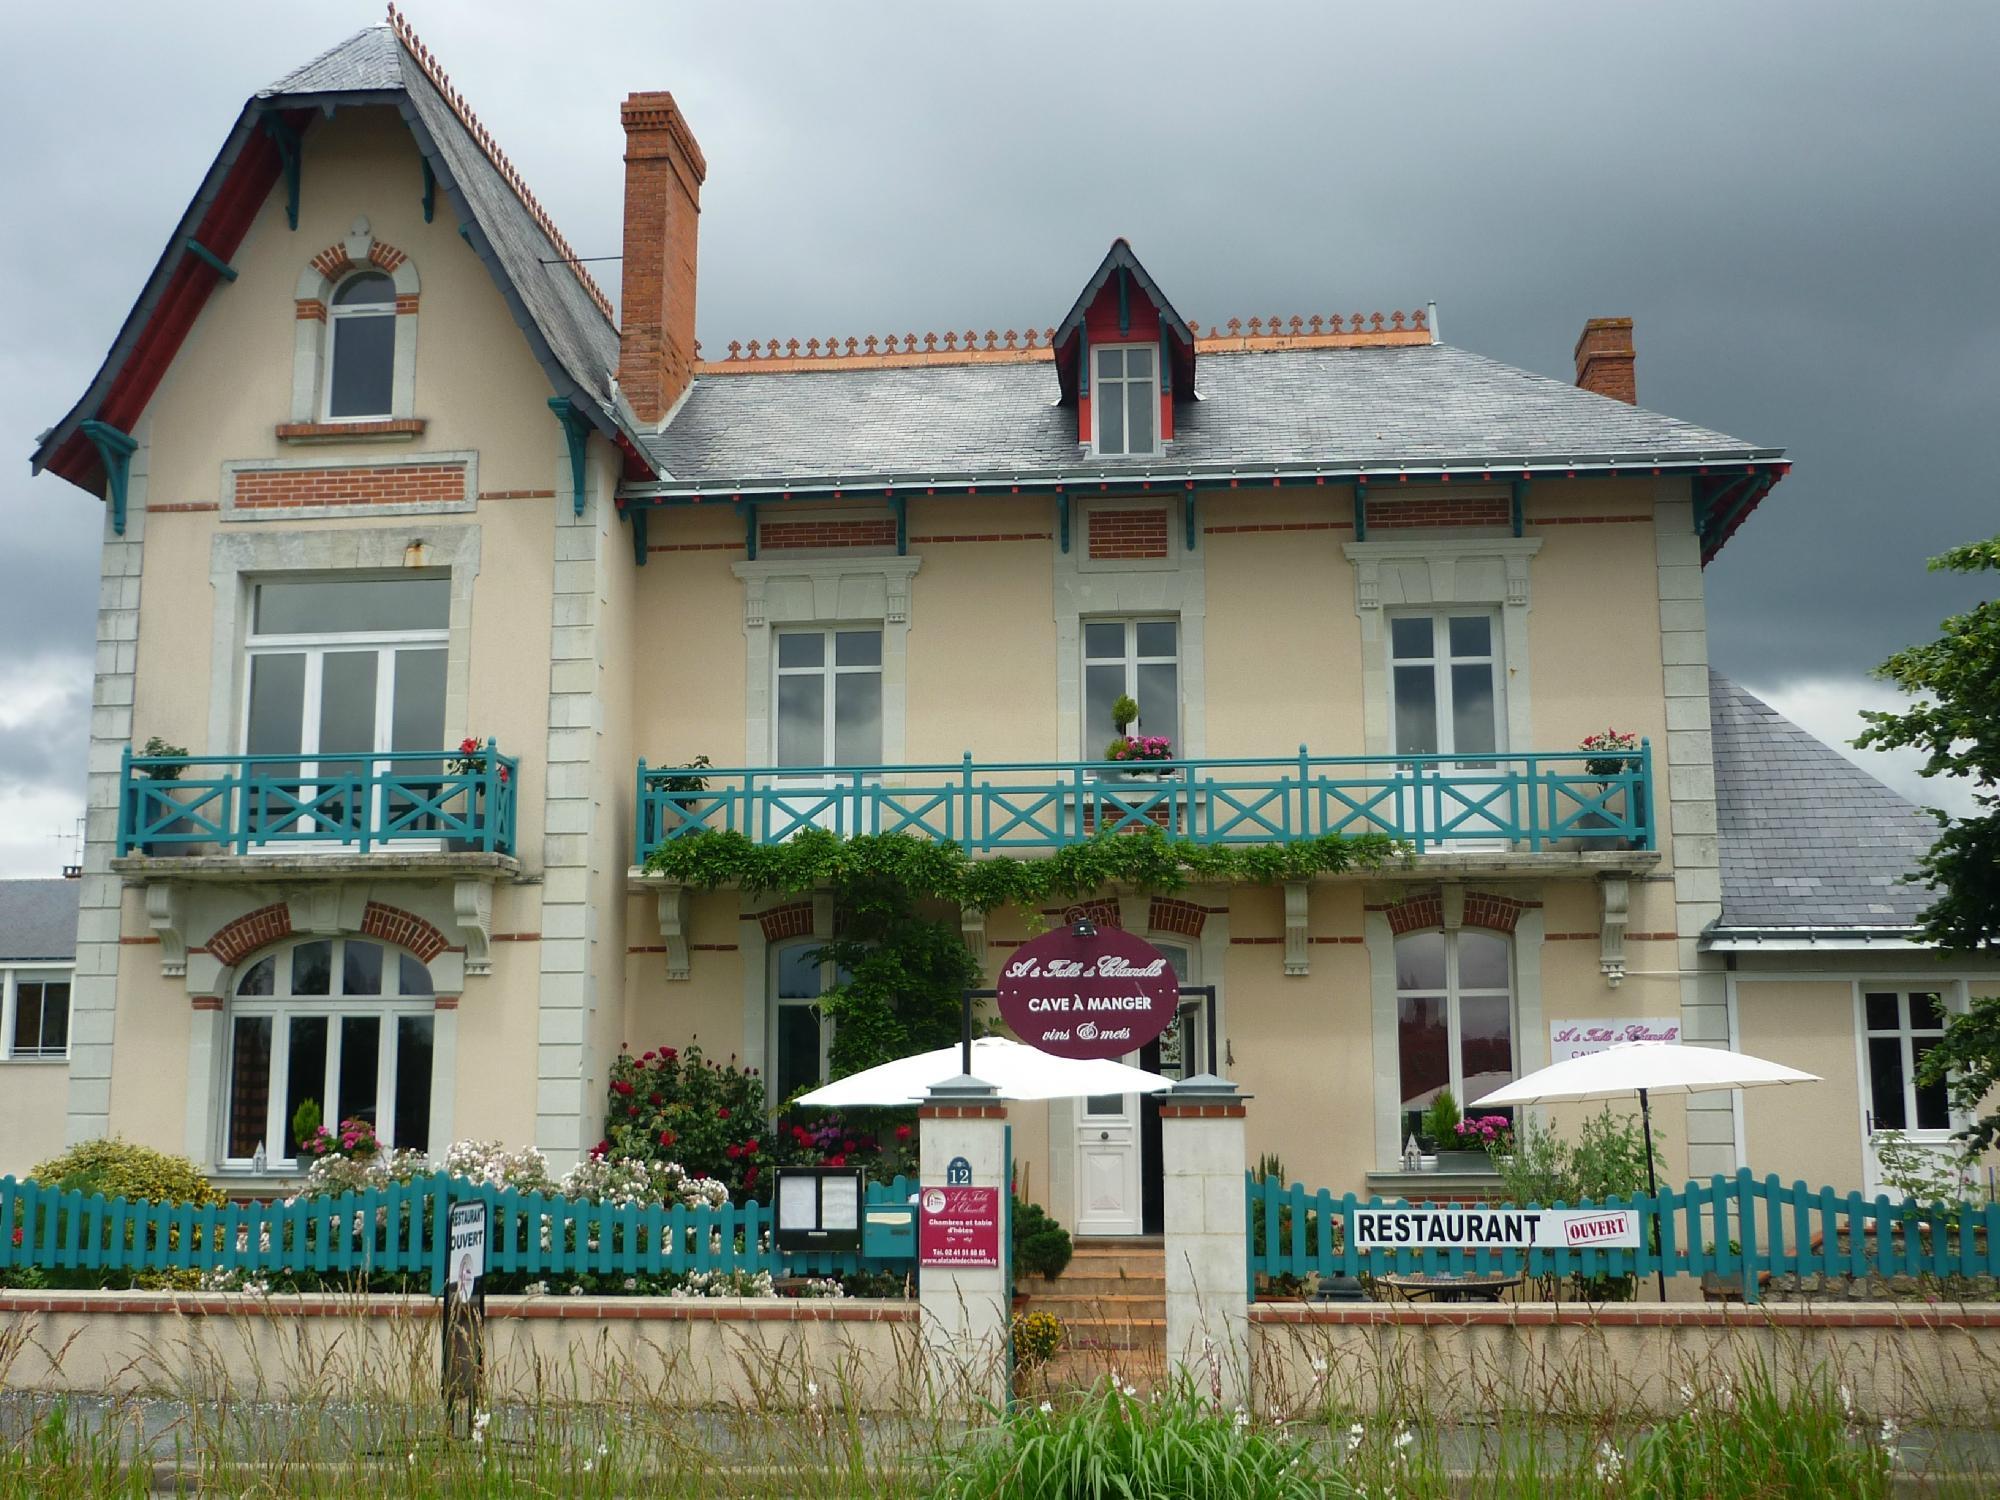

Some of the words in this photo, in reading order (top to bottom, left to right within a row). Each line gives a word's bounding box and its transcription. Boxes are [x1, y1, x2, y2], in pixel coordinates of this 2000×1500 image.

[1006, 958, 1037, 977] A
[1043, 960, 1083, 977] Table
[1097, 955, 1166, 977] Chanelle
[1028, 997, 1069, 1011] CAVE
[1072, 993, 1084, 1011] À
[1087, 997, 1152, 1010] MANGER
[1042, 1028, 1070, 1040] vins
[1077, 1021, 1098, 1039] &
[1100, 1027, 1130, 1039] mets
[1553, 1027, 1577, 1042] A
[950, 1169, 969, 1184] 12
[1359, 1214, 1541, 1242] RESTAURANT
[1570, 1218, 1625, 1239] OUVERT
[450, 1231, 483, 1250] OUVERT
[944, 1248, 953, 1256] 02
[953, 1248, 961, 1256] 41
